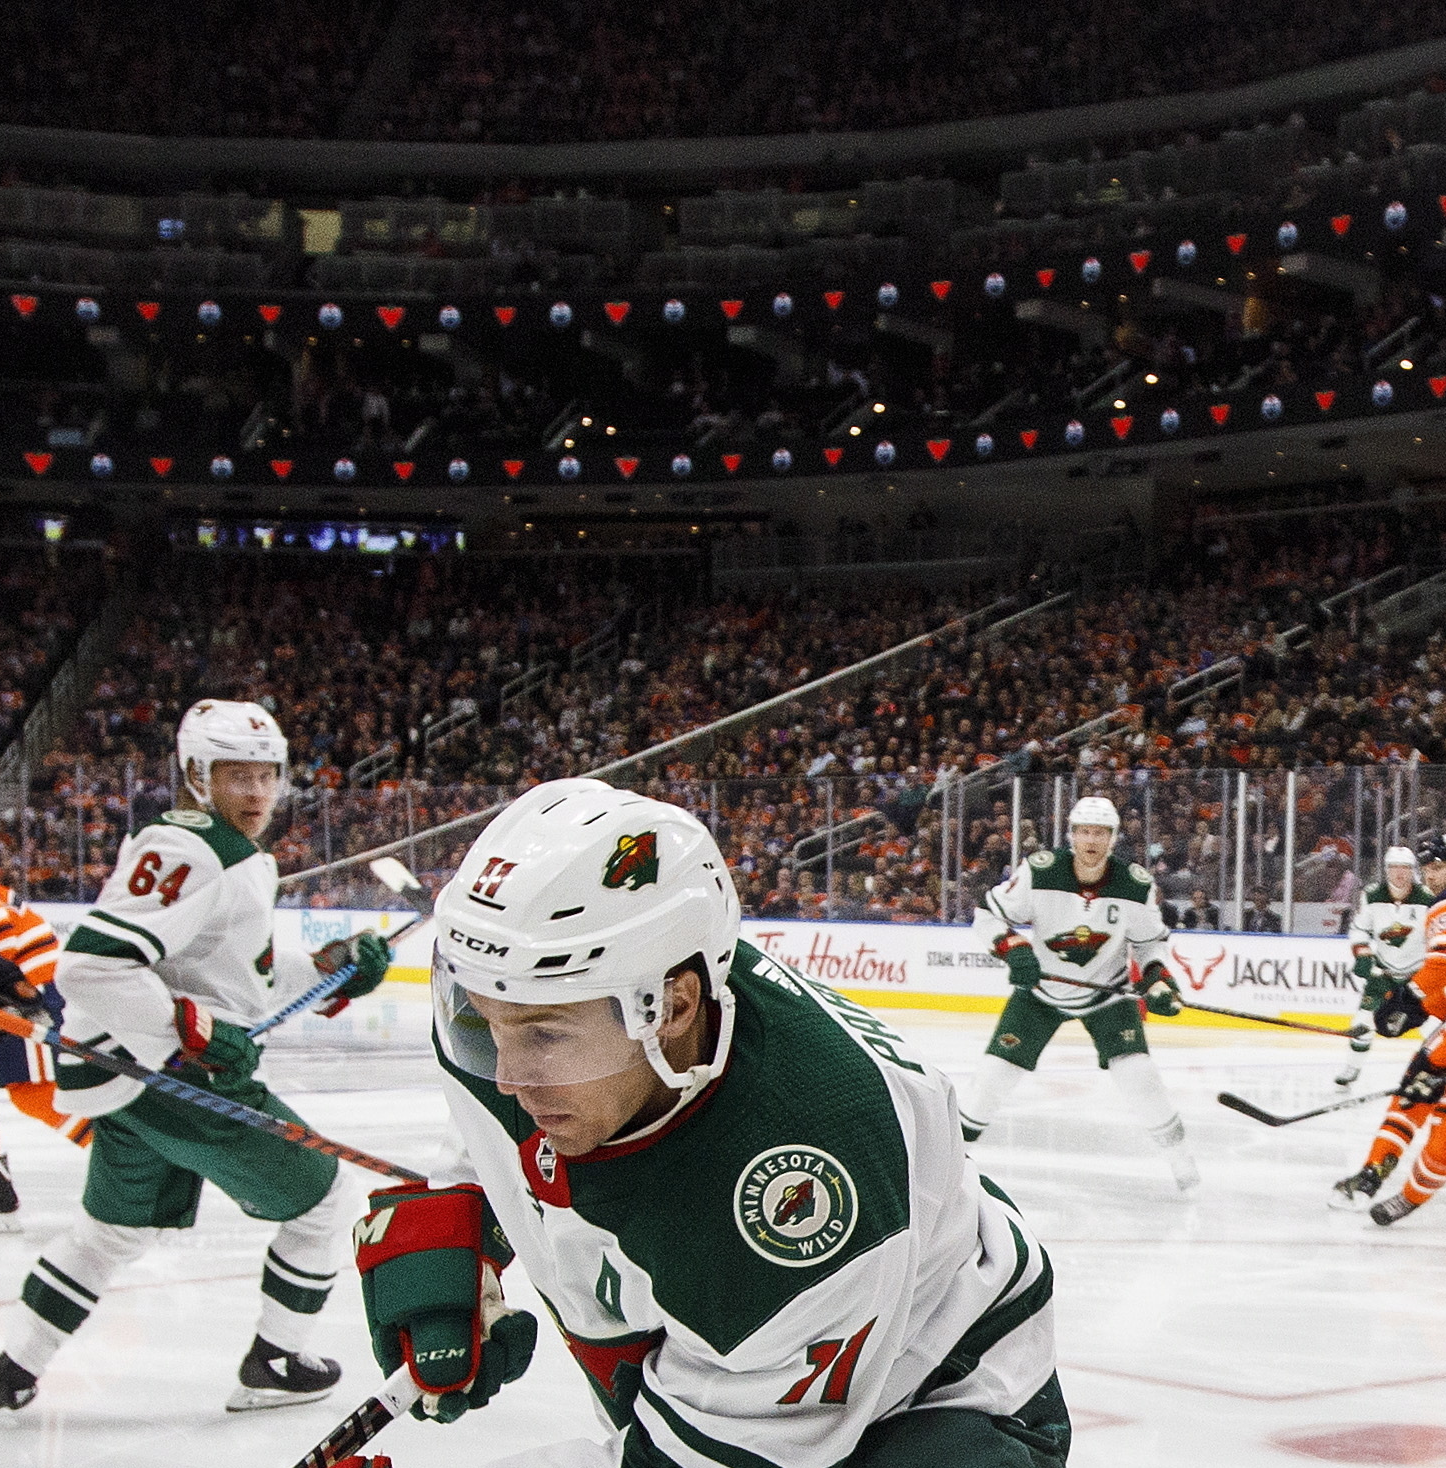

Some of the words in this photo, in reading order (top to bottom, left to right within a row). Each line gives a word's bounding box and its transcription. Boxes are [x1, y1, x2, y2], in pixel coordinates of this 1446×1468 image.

[128, 851, 192, 908] 64
[1107, 904, 1120, 924] C
[449, 928, 510, 957] CCM
[805, 932, 908, 985] Hortons
[958, 951, 1007, 969] PETERBIL
[1227, 954, 1292, 990] JACK
[1298, 956, 1359, 993] LINK
[743, 1154, 826, 1224] MINNESOTA
[798, 1219, 844, 1256] WILD
[415, 1348, 467, 1364] CCM
